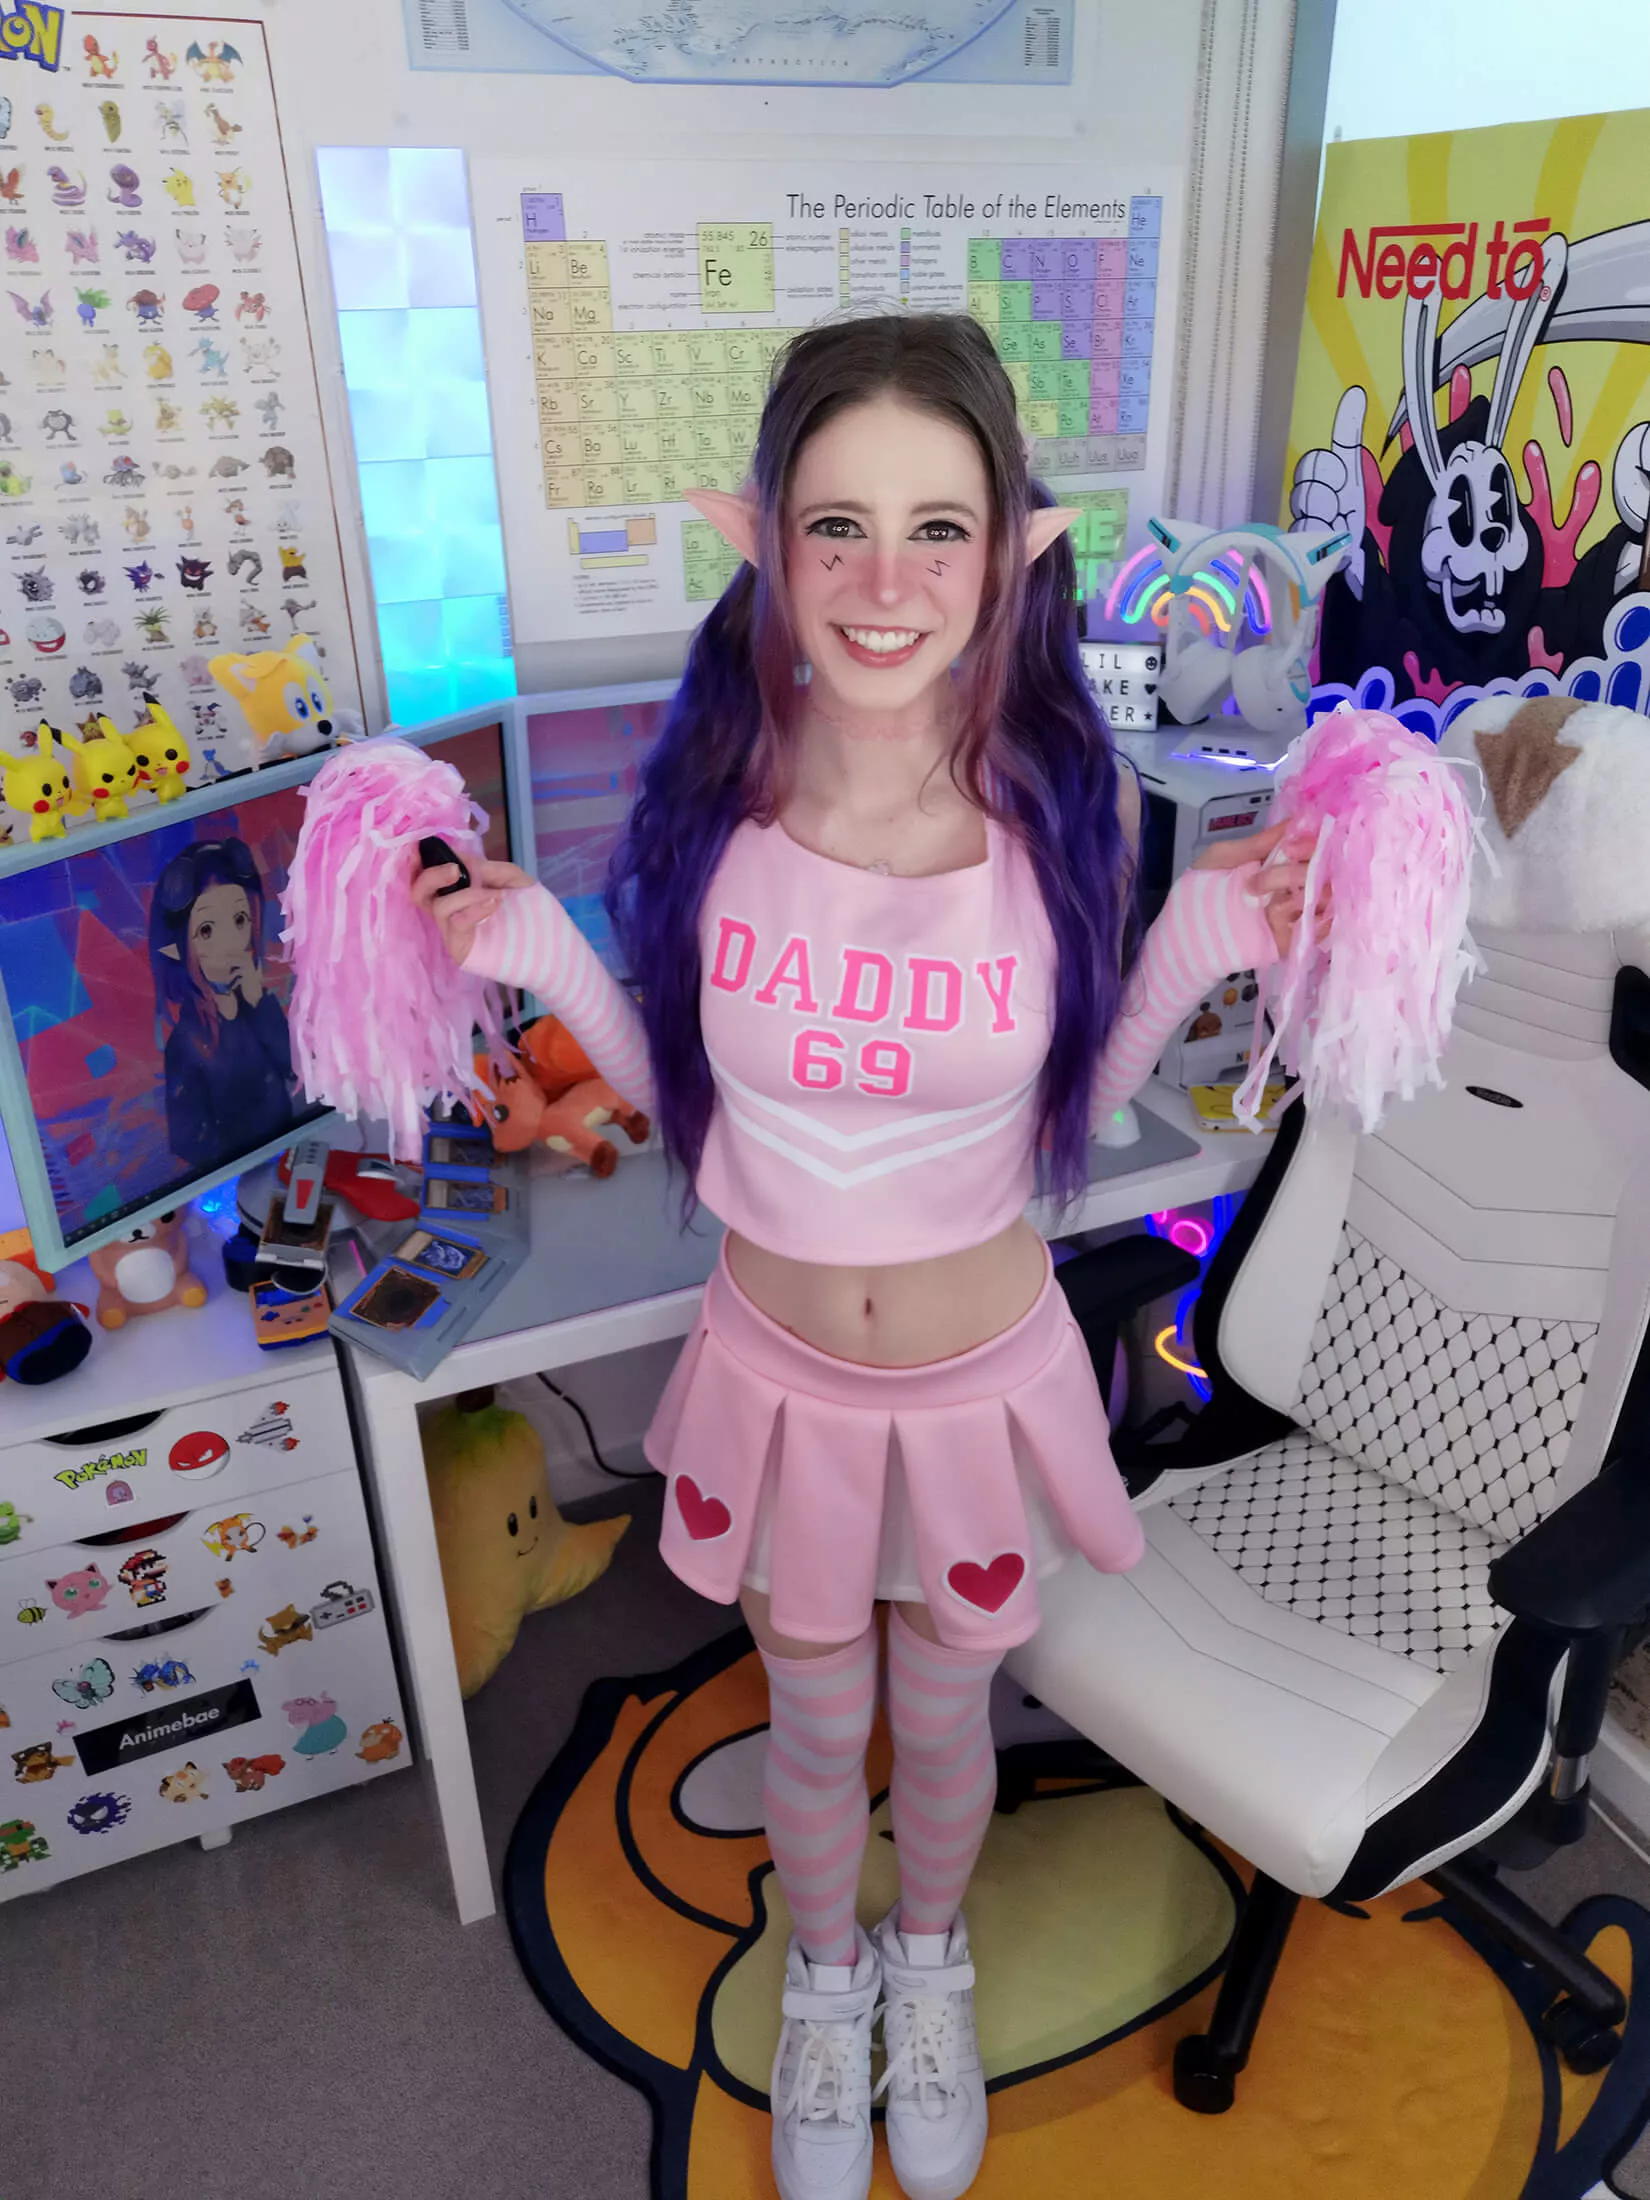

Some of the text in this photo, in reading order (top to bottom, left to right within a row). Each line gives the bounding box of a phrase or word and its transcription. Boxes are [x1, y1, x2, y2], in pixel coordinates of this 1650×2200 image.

[0, 0, 64, 72] ON
[786, 193, 1126, 219] The Periodic Table of the Elements
[525, 212, 537, 227] H
[1131, 213, 1147, 226] He
[750, 230, 769, 247] 26
[1002, 255, 1013, 268] C
[1066, 254, 1079, 267] O
[1337, 216, 1551, 301] Need to
[529, 260, 540, 274] Li
[570, 259, 588, 274] Be
[705, 259, 732, 286] Fe
[532, 307, 554, 321] Na
[537, 352, 547, 365] K
[577, 350, 598, 365] Ca
[617, 349, 633, 364] Sc
[729, 345, 745, 360] Cr
[540, 396, 558, 410] Rb
[580, 394, 595, 409] Sr
[619, 393, 629, 406] Y
[658, 391, 673, 406] Zr
[695, 390, 714, 404] Nb
[731, 390, 752, 402] Mo
[584, 438, 601, 452] Ba
[623, 437, 638, 451] Lu
[731, 431, 746, 444] W
[544, 439, 563, 454] Cs
[547, 482, 561, 496] Fr
[586, 480, 604, 494] Ra
[626, 479, 638, 493] Lr
[1088, 678, 1129, 696] AKE
[1101, 705, 1135, 723] ER
[708, 914, 1020, 1035] DADDY
[790, 1026, 913, 1098] 69
[119, 1707, 221, 1751] Animebae
